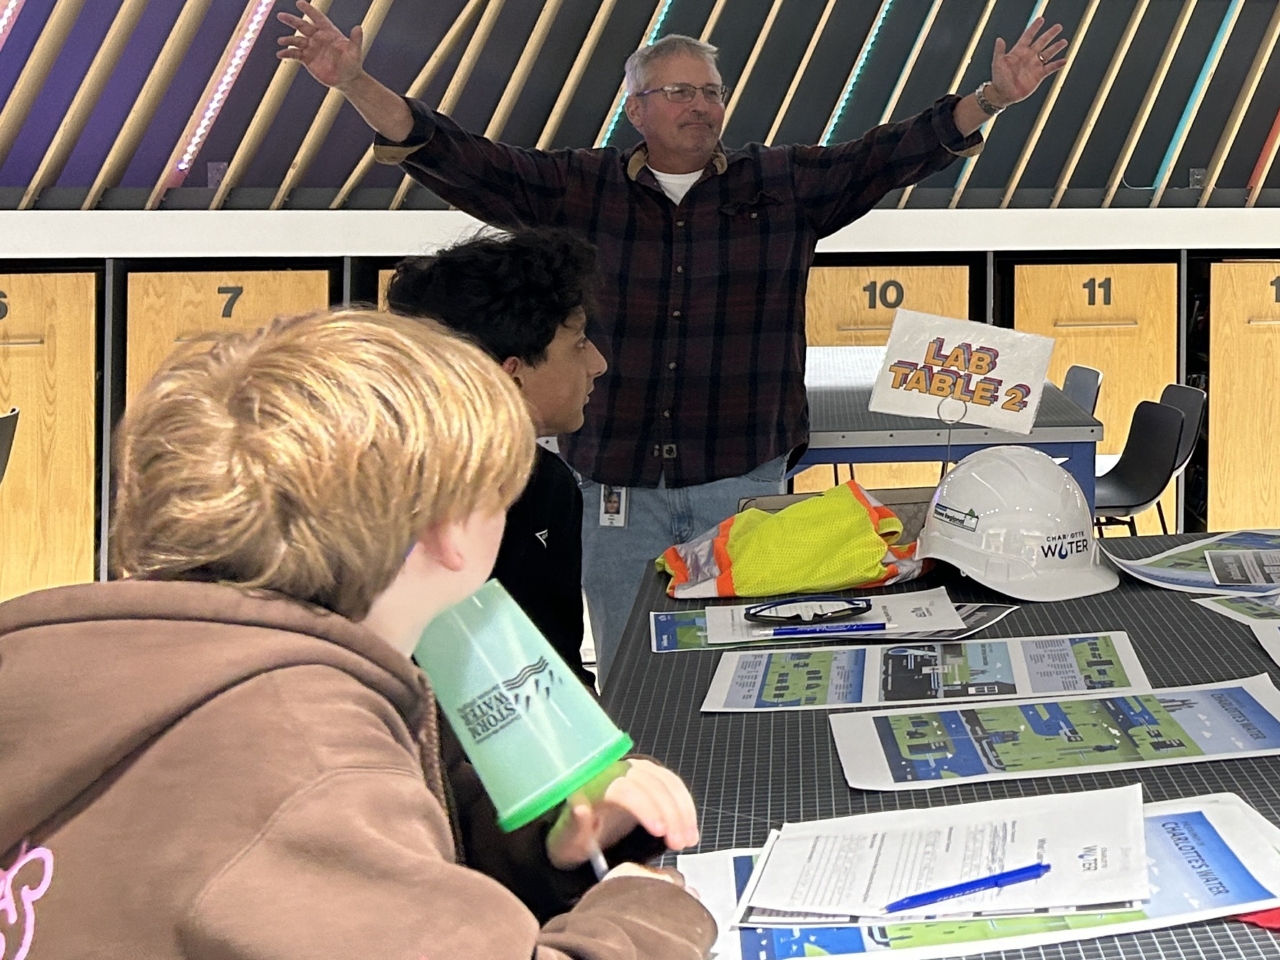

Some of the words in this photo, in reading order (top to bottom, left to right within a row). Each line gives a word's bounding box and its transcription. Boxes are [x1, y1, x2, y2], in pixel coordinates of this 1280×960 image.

[217, 286, 243, 318] 7
[862, 280, 904, 309] 10
[1083, 277, 1112, 306] 11
[924, 337, 1000, 375] LAB
[889, 360, 1003, 406] TABLE
[1004, 383, 1031, 413] 2
[461, 692, 511, 727] WATER
[468, 702, 517, 739] STORM
[1200, 868, 1230, 896] WATER
